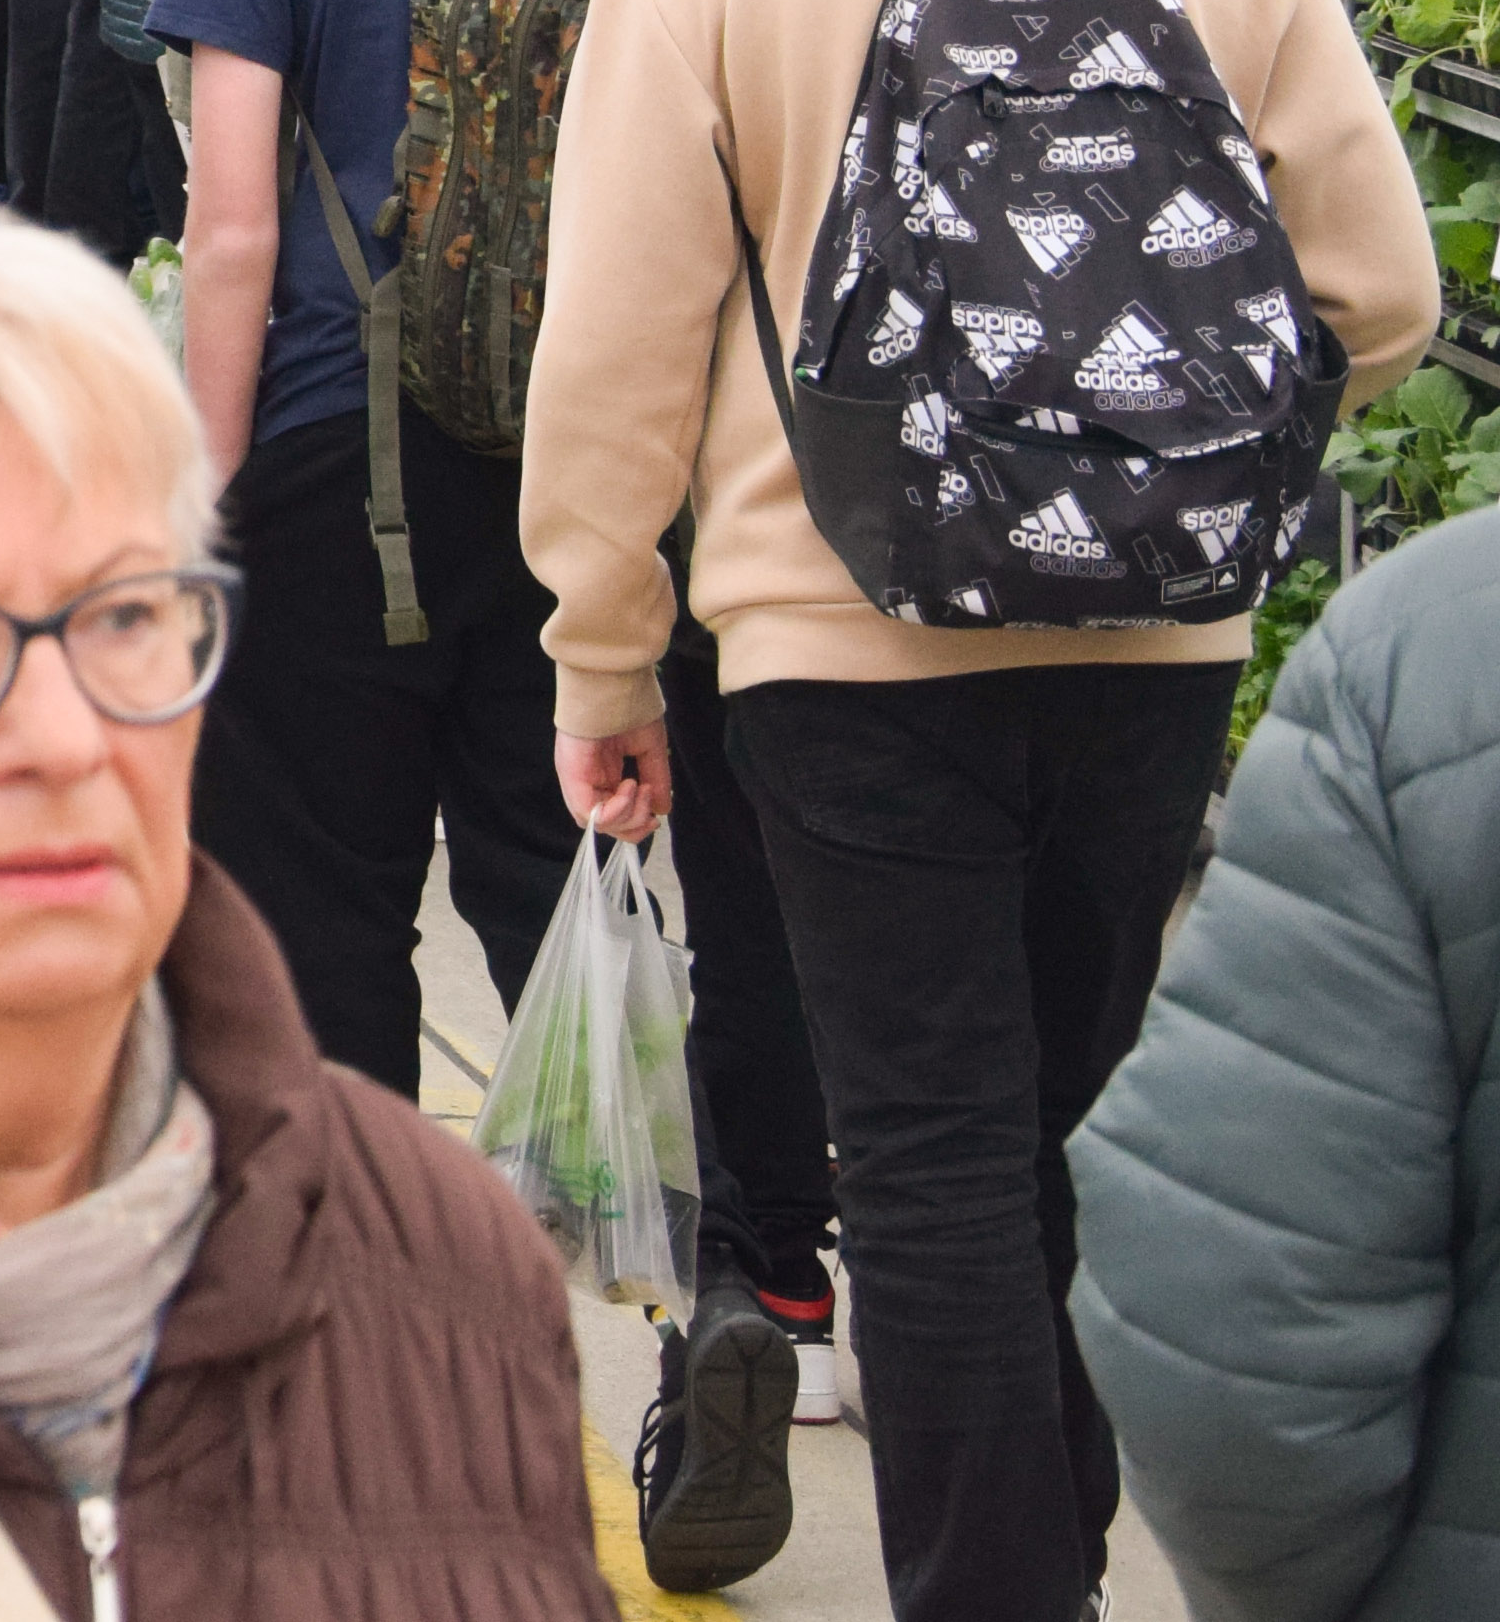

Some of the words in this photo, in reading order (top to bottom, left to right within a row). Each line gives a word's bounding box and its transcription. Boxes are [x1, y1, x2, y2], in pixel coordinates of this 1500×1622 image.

[1069, 65, 1160, 90] adidas
[1046, 143, 1135, 166] adidas
[1141, 218, 1231, 254] adidas
[1075, 370, 1160, 391] adidas
[1095, 388, 1186, 411] adidas
[1008, 529, 1106, 559] adidas
